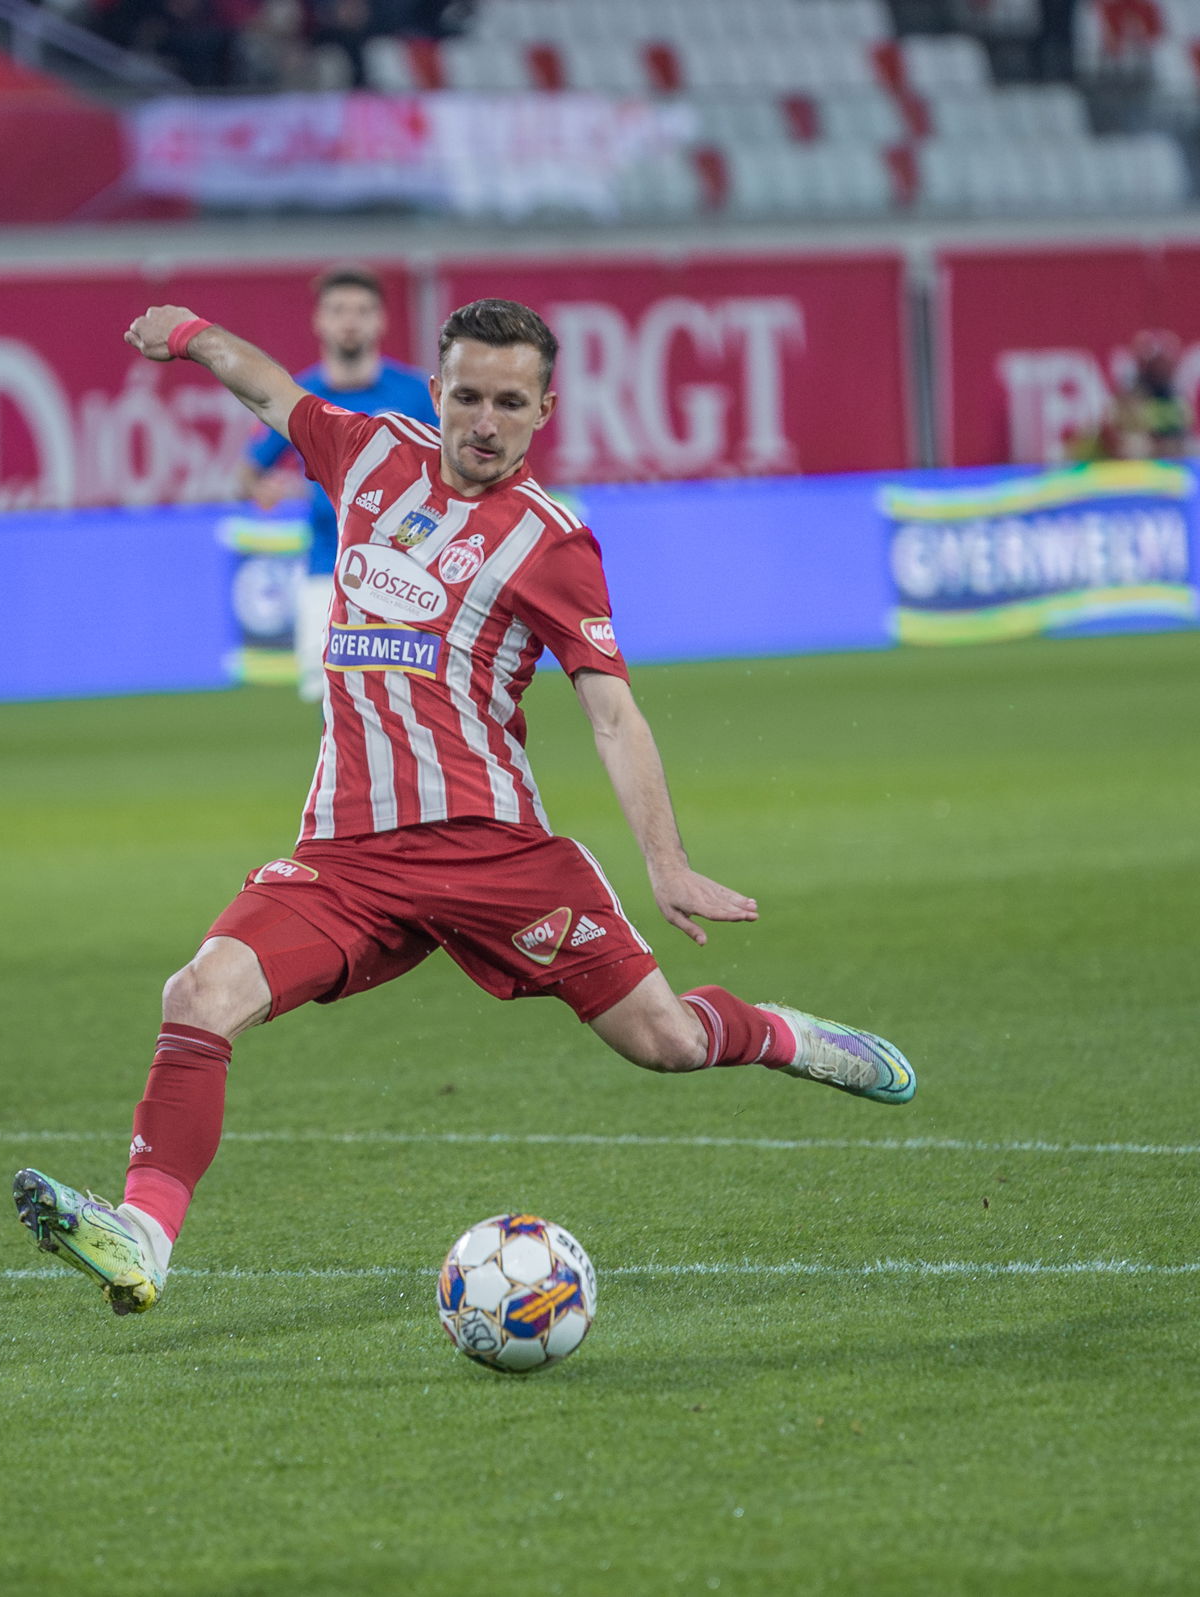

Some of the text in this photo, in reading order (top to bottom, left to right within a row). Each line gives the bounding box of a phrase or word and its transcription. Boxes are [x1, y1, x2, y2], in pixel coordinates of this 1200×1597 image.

[355, 496, 381, 515] adidas
[343, 549, 440, 612] DIÓSZEGI
[590, 623, 616, 641] MO
[330, 633, 435, 666] GYERMELYI
[266, 861, 299, 878] MOL
[521, 921, 555, 949] MOL
[570, 926, 607, 948] adidas
